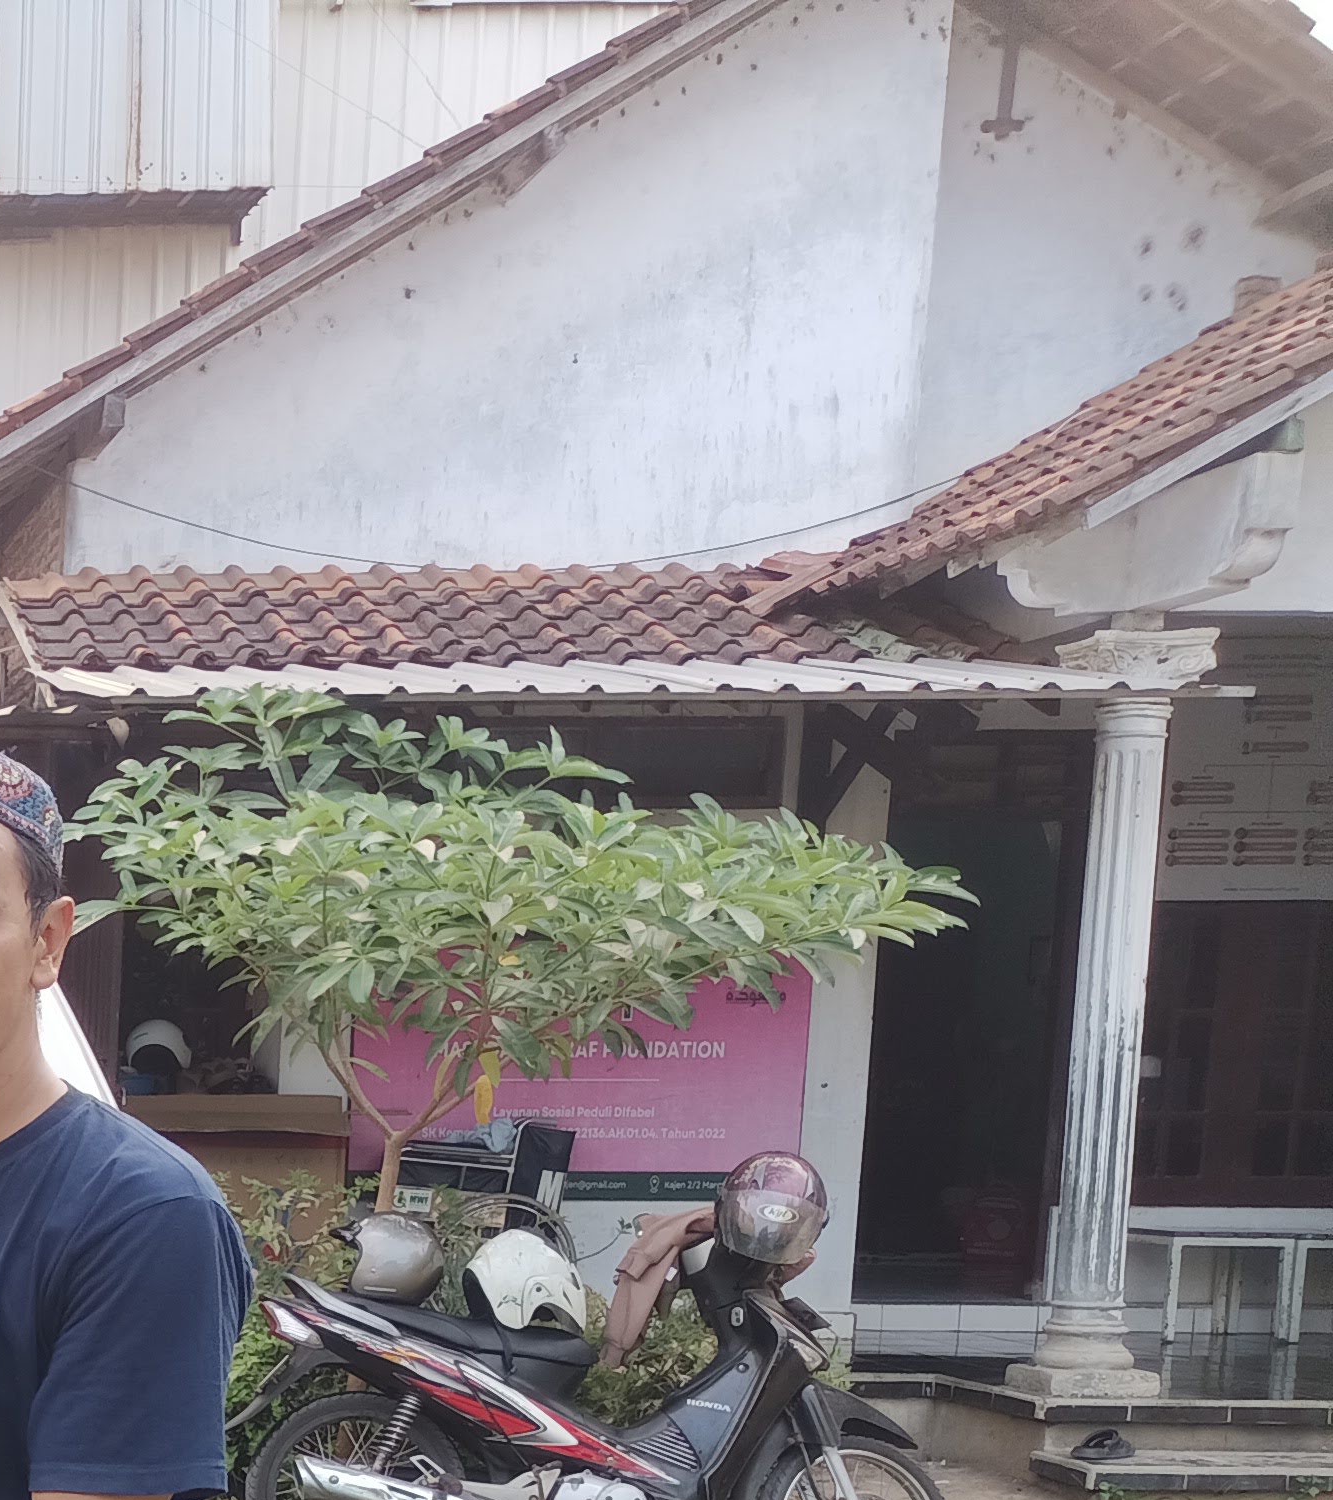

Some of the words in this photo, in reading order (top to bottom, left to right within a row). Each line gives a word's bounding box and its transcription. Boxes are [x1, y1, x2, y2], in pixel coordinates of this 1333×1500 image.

[603, 1040, 726, 1059] FUNDATION
[541, 1106, 575, 1118] Sosial
[576, 1106, 613, 1118] Peduli
[661, 1127, 696, 1139] Tahun
[698, 1127, 727, 1139] 2022
[686, 1398, 731, 1413] HONDA
